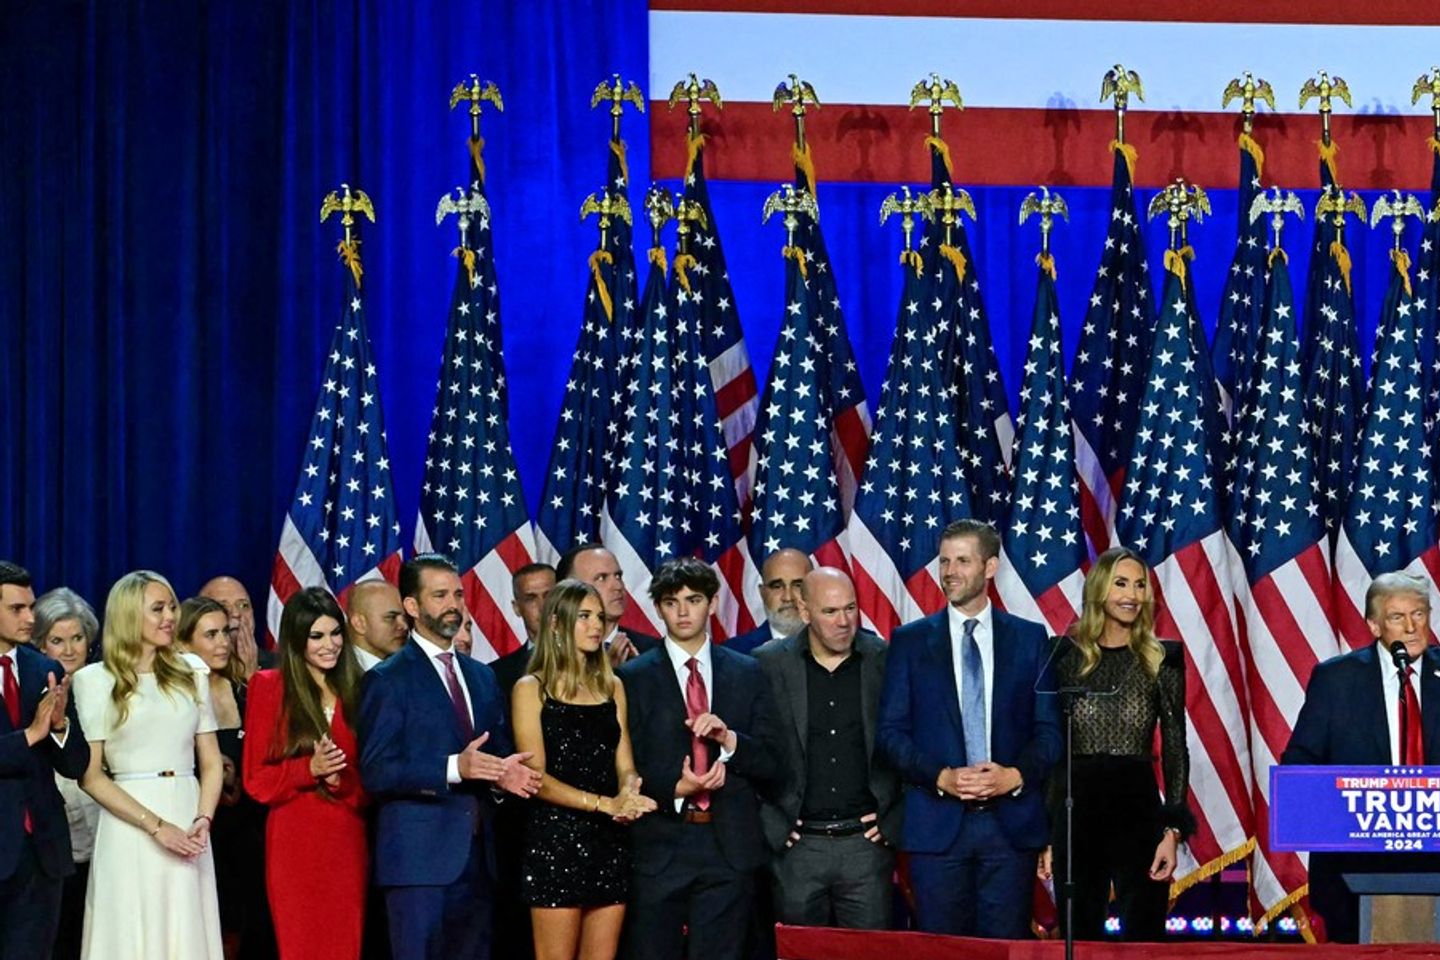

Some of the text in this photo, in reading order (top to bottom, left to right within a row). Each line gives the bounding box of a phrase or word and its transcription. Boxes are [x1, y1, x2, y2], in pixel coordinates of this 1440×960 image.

[1342, 778, 1388, 788] TRUMP
[1391, 778, 1424, 788] WILL
[1384, 839, 1423, 850] 2024
